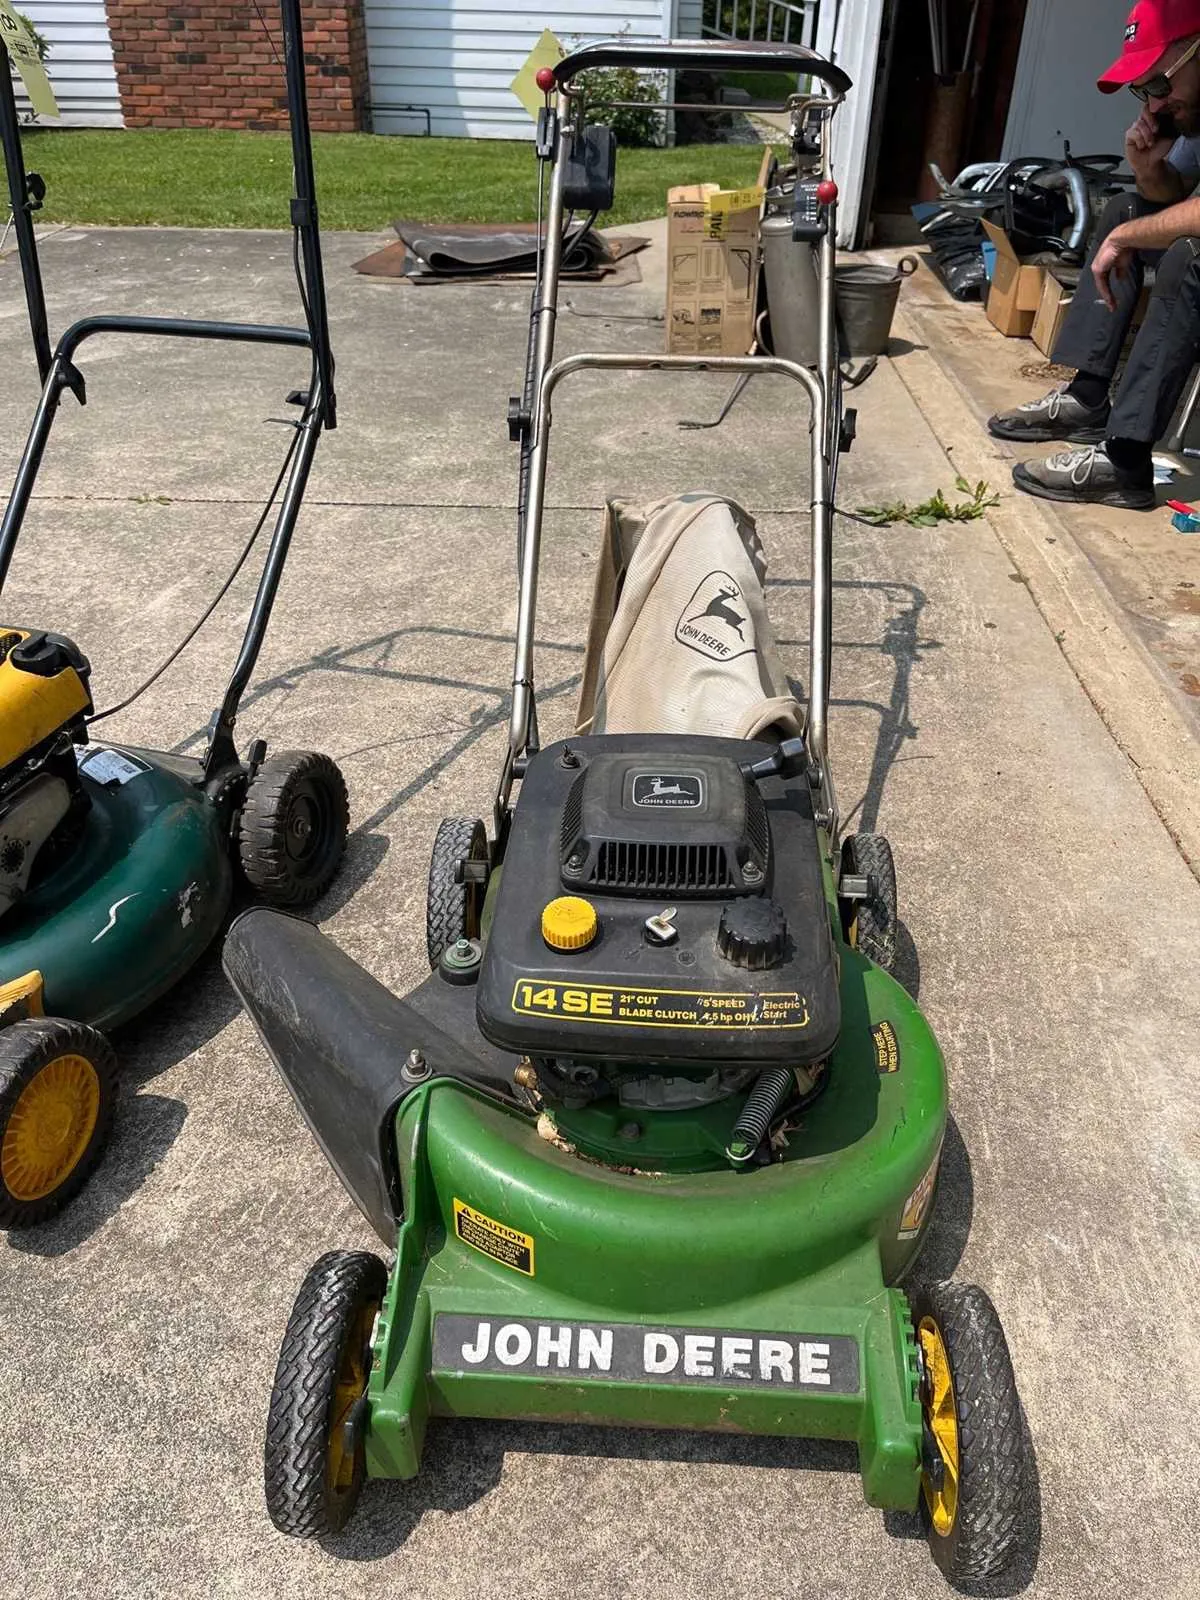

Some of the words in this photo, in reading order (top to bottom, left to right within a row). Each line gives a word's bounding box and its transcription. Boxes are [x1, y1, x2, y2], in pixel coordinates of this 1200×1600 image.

[679, 624, 701, 639] JOHN
[698, 633, 731, 656] DEERE
[522, 986, 557, 1009] 14
[562, 990, 613, 1015] SE
[636, 995, 658, 1005] CUT
[763, 1001, 800, 1010] Electric
[619, 1007, 654, 1018] BLADE
[654, 1010, 697, 1020] CLUTCH
[720, 1013, 733, 1023] hp
[763, 1010, 787, 1019] Start
[873, 1032, 886, 1049] HERE
[880, 1022, 896, 1051] STARTING
[879, 1049, 887, 1066] STEP
[888, 1052, 897, 1072] WHEN
[475, 1214, 526, 1245] CAUTION
[461, 1323, 614, 1370] JOHN
[643, 1333, 831, 1385] DEERE
